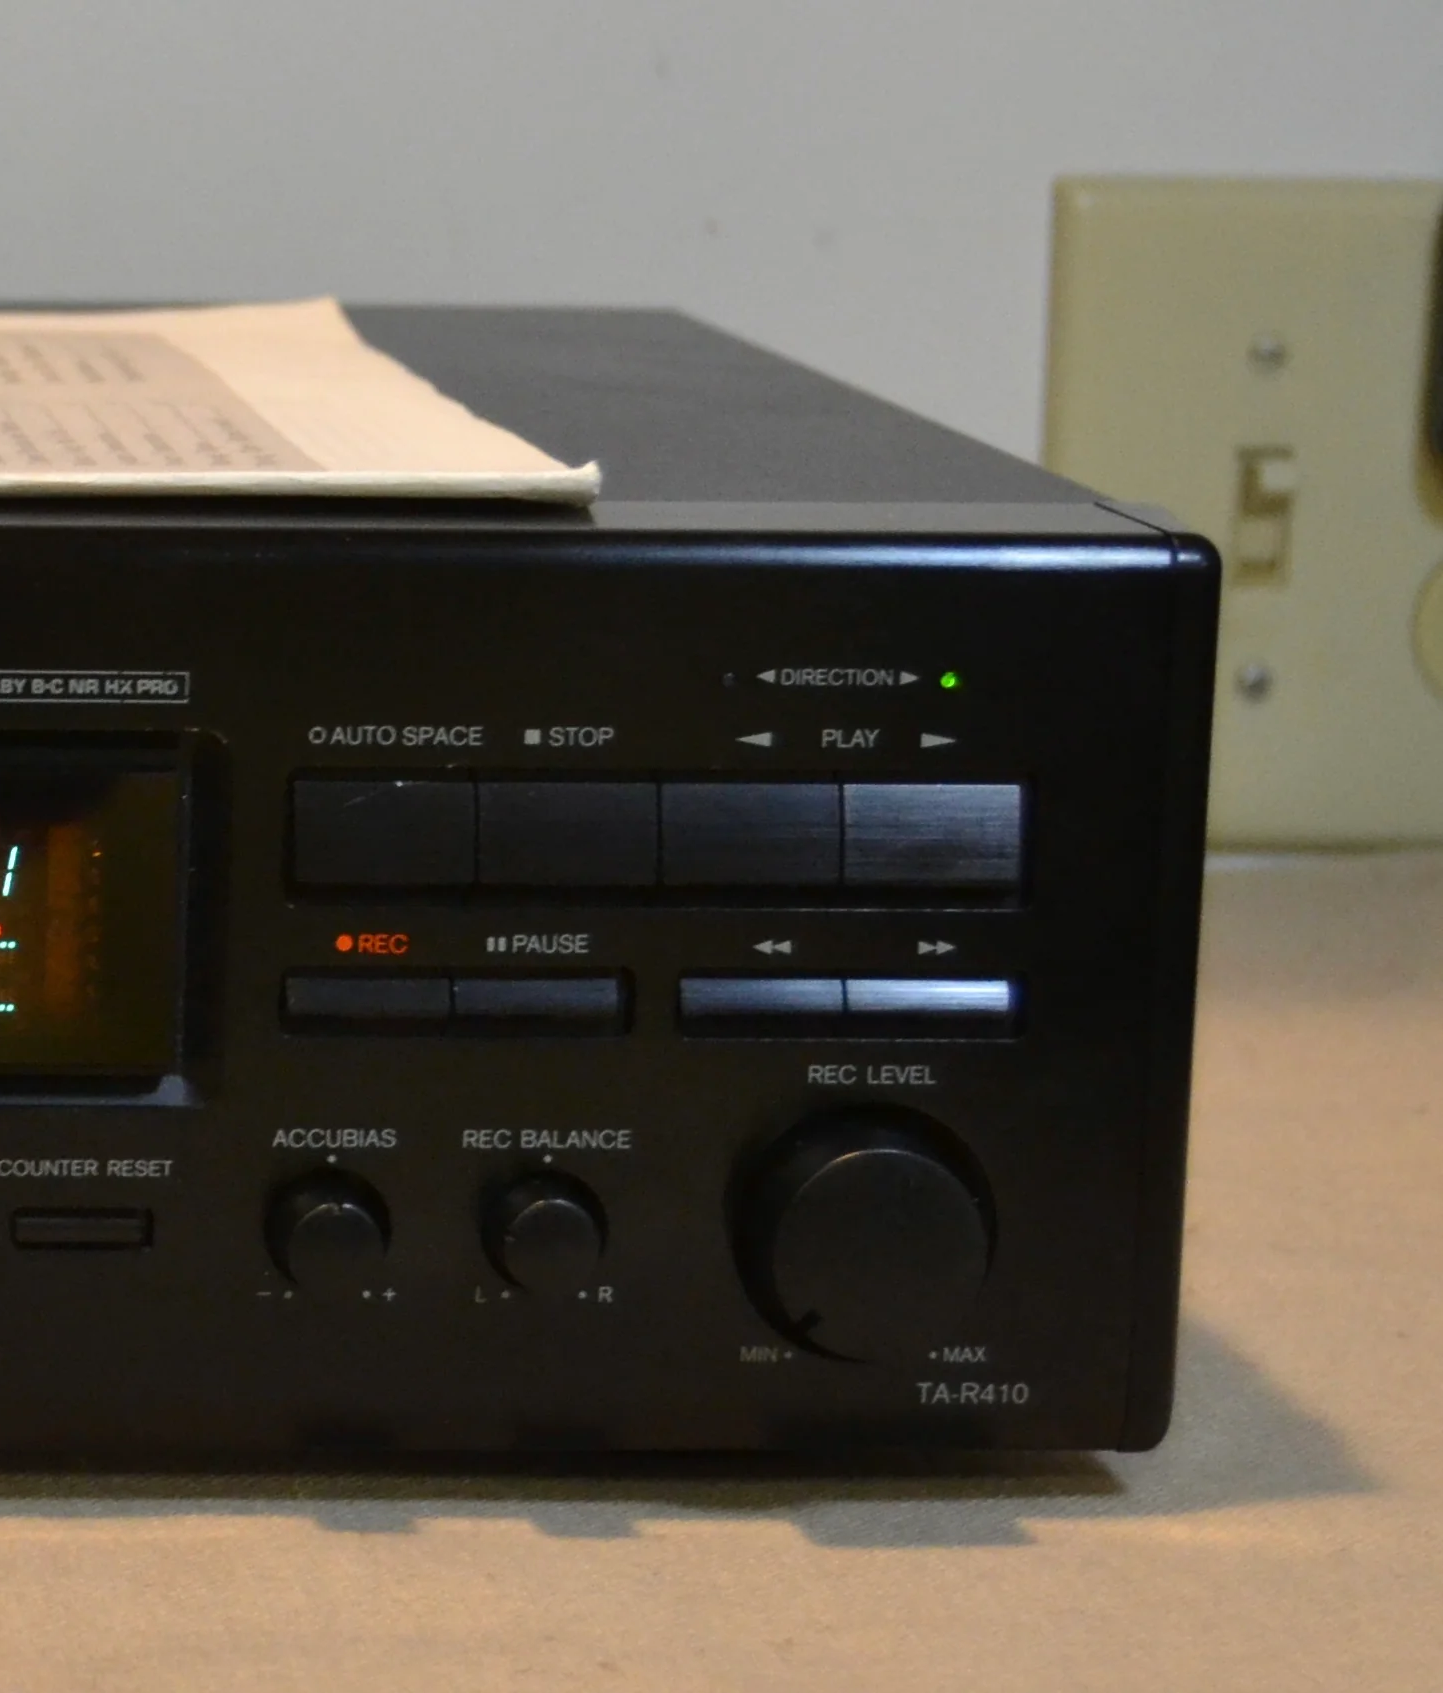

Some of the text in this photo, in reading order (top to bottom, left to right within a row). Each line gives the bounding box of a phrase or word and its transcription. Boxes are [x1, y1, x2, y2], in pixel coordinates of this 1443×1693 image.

[68, 678, 100, 695] NR
[104, 679, 134, 695] HX
[136, 678, 179, 696] PRO
[779, 667, 894, 687] DIRECTION
[329, 724, 484, 747] AUTO SPACE
[548, 726, 615, 748] STOP
[821, 728, 880, 749] PLAY
[357, 933, 408, 955] REC
[511, 933, 589, 954] PAUSE
[807, 1064, 936, 1085] REC LEVEL
[271, 1127, 398, 1149] ACCUBIAS
[462, 1128, 631, 1150] REC BALANCE
[106, 1159, 174, 1178] RESET
[474, 1286, 487, 1304] L
[598, 1285, 614, 1303] R
[740, 1345, 779, 1363] MIN
[943, 1346, 986, 1363] MAX
[916, 1381, 1030, 1405] TA-R410
